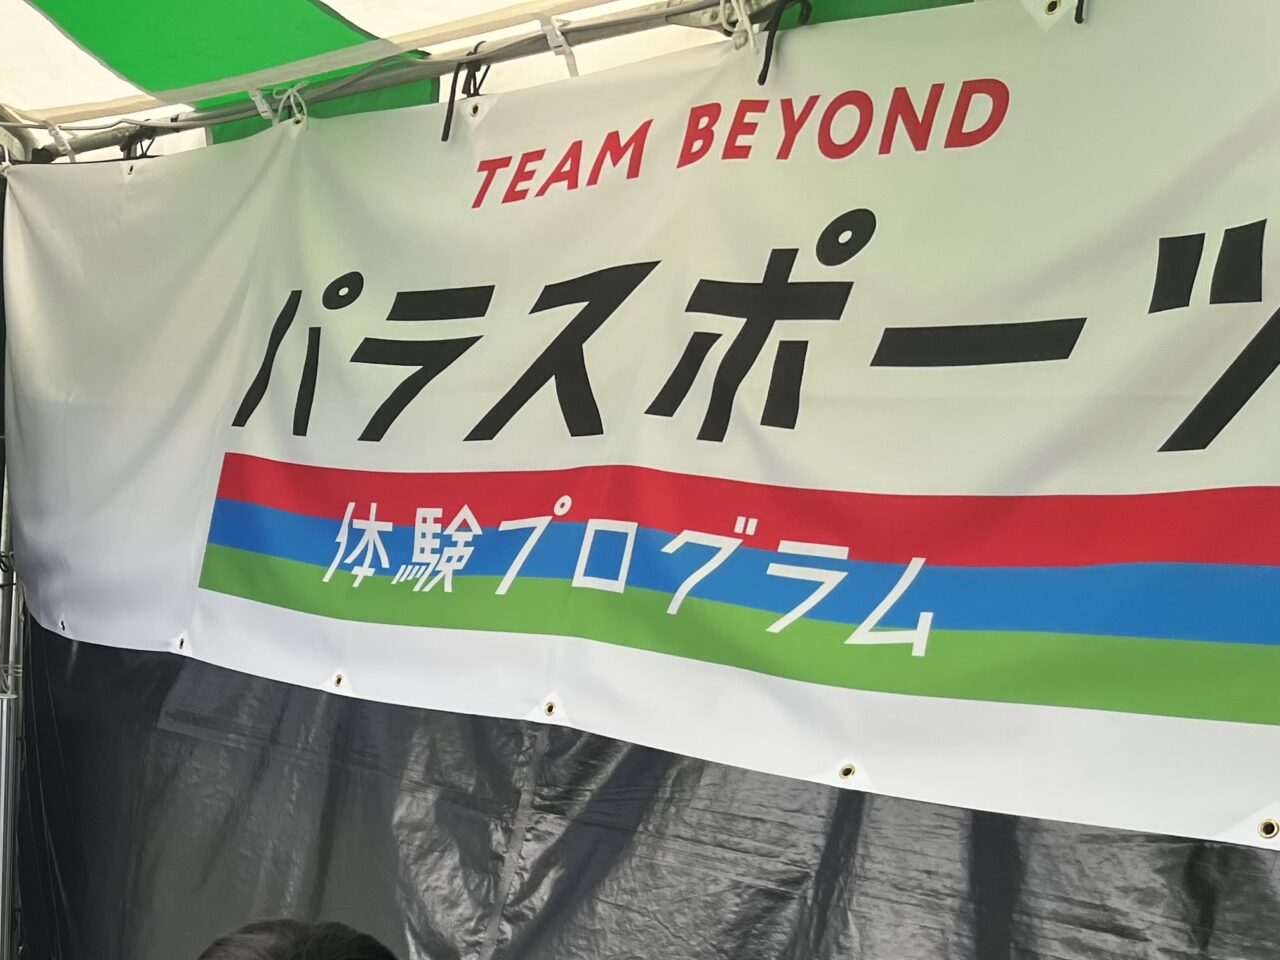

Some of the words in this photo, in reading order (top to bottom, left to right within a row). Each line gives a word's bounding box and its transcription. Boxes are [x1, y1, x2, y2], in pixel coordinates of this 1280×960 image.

[471, 118, 654, 209] TEAM
[676, 78, 1011, 169] BEYOND
[231, 208, 1280, 452] パラスポーツ
[322, 495, 933, 656] 体験プログラム
